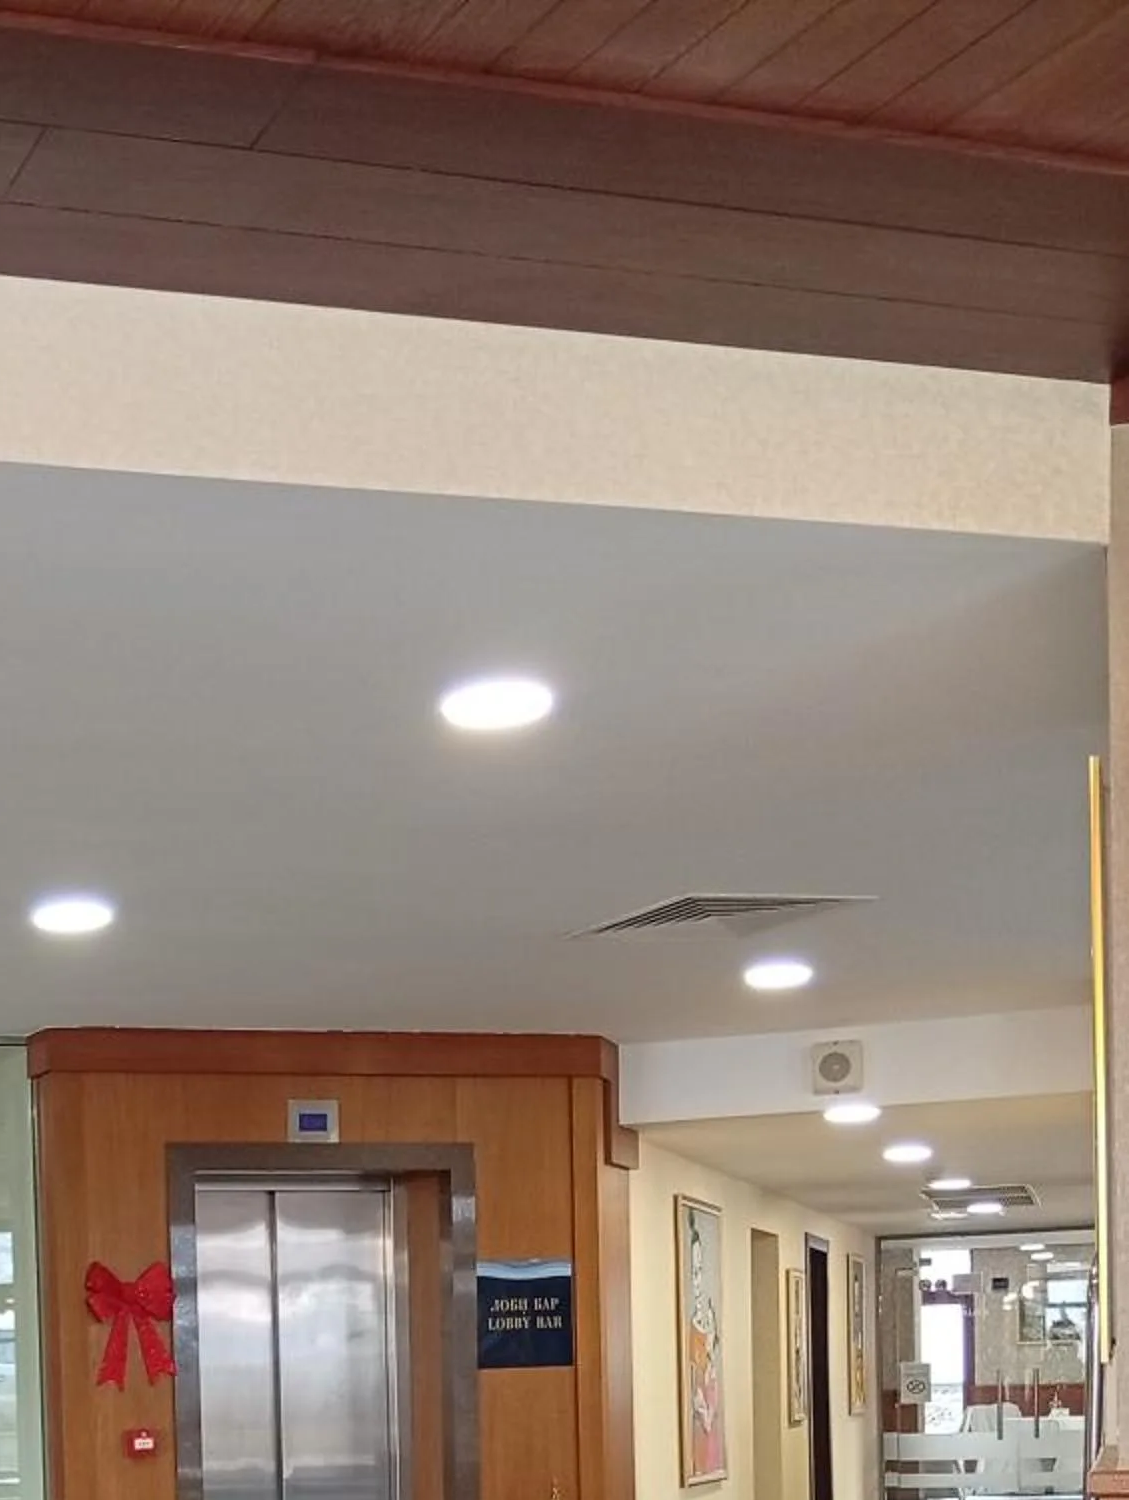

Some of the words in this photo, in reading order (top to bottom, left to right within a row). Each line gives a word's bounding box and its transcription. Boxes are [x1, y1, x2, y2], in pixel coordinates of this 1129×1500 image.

[534, 1297, 559, 1311] БАР
[488, 1316, 531, 1331] LOBBY
[536, 1315, 562, 1329] BAR
